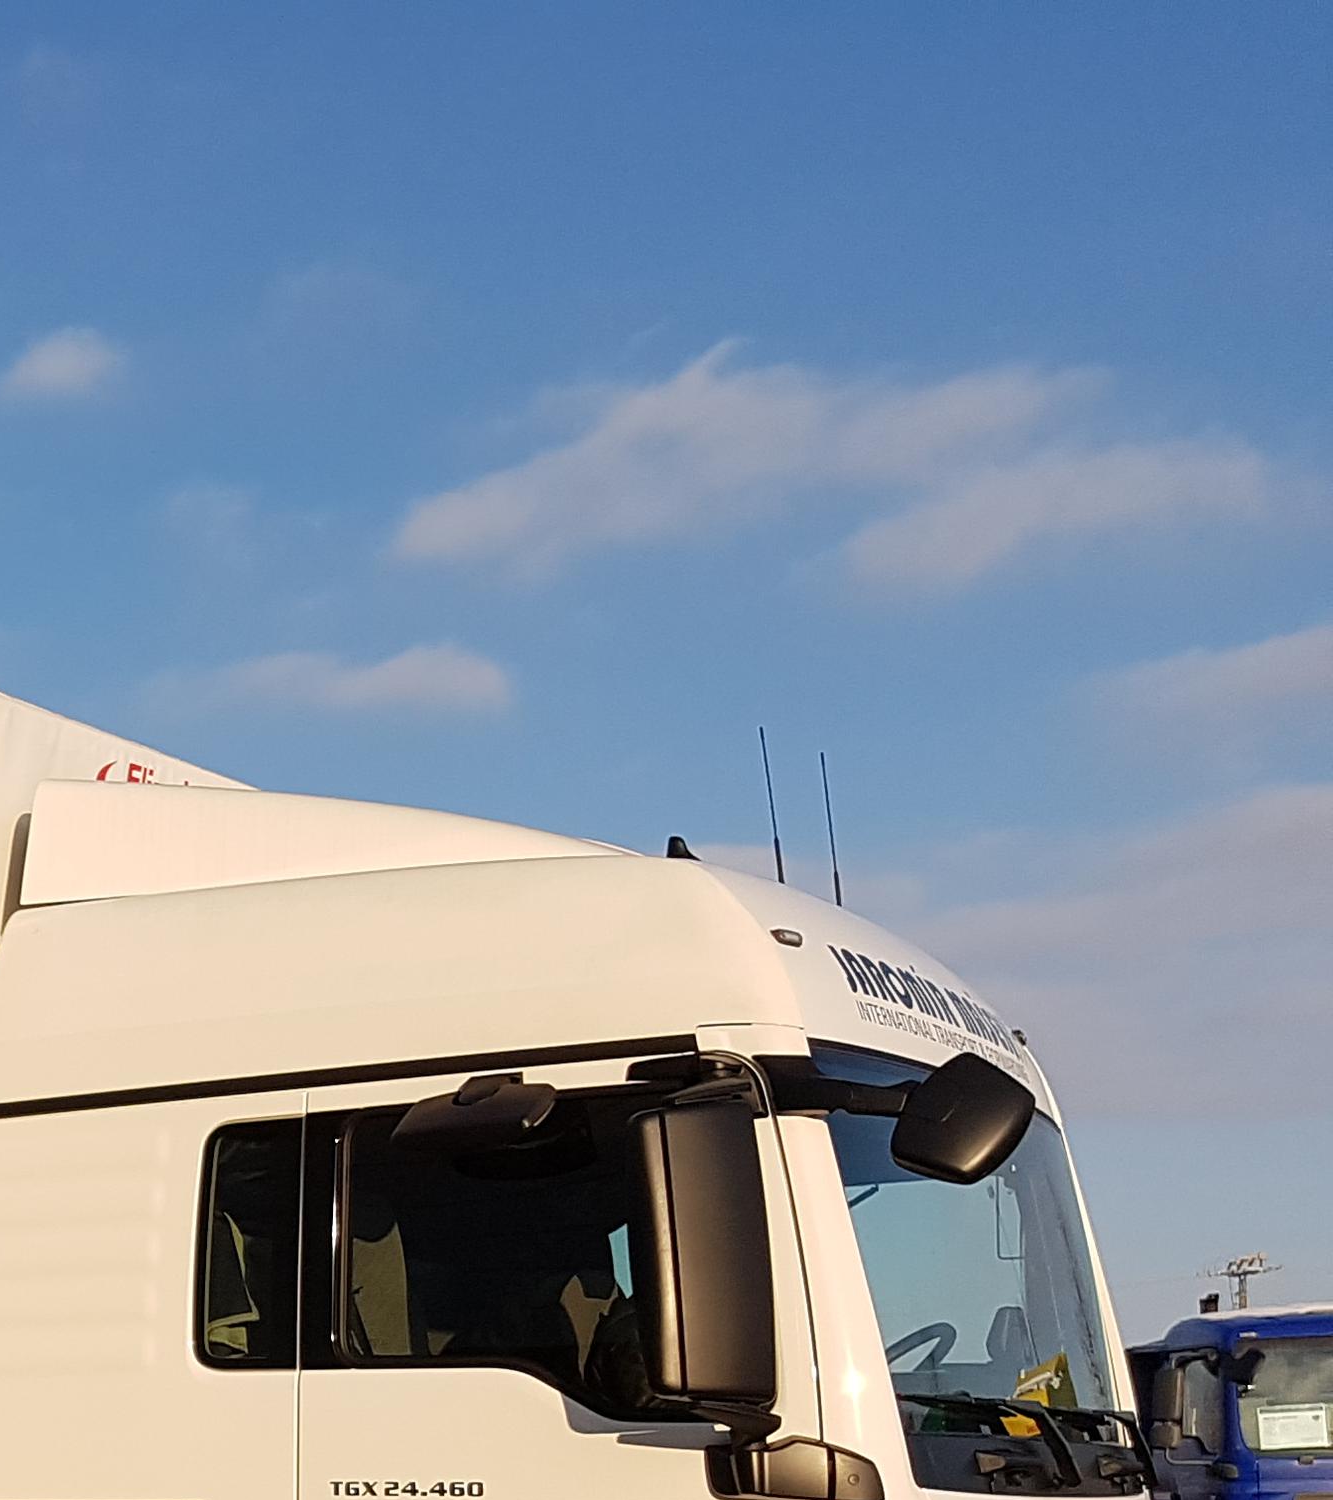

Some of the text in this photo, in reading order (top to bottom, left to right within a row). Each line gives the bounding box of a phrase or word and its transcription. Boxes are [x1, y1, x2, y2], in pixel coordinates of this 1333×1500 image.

[855, 1000, 938, 1042] INTERNATIONAL
[330, 1481, 484, 1498] TGX 24.460
